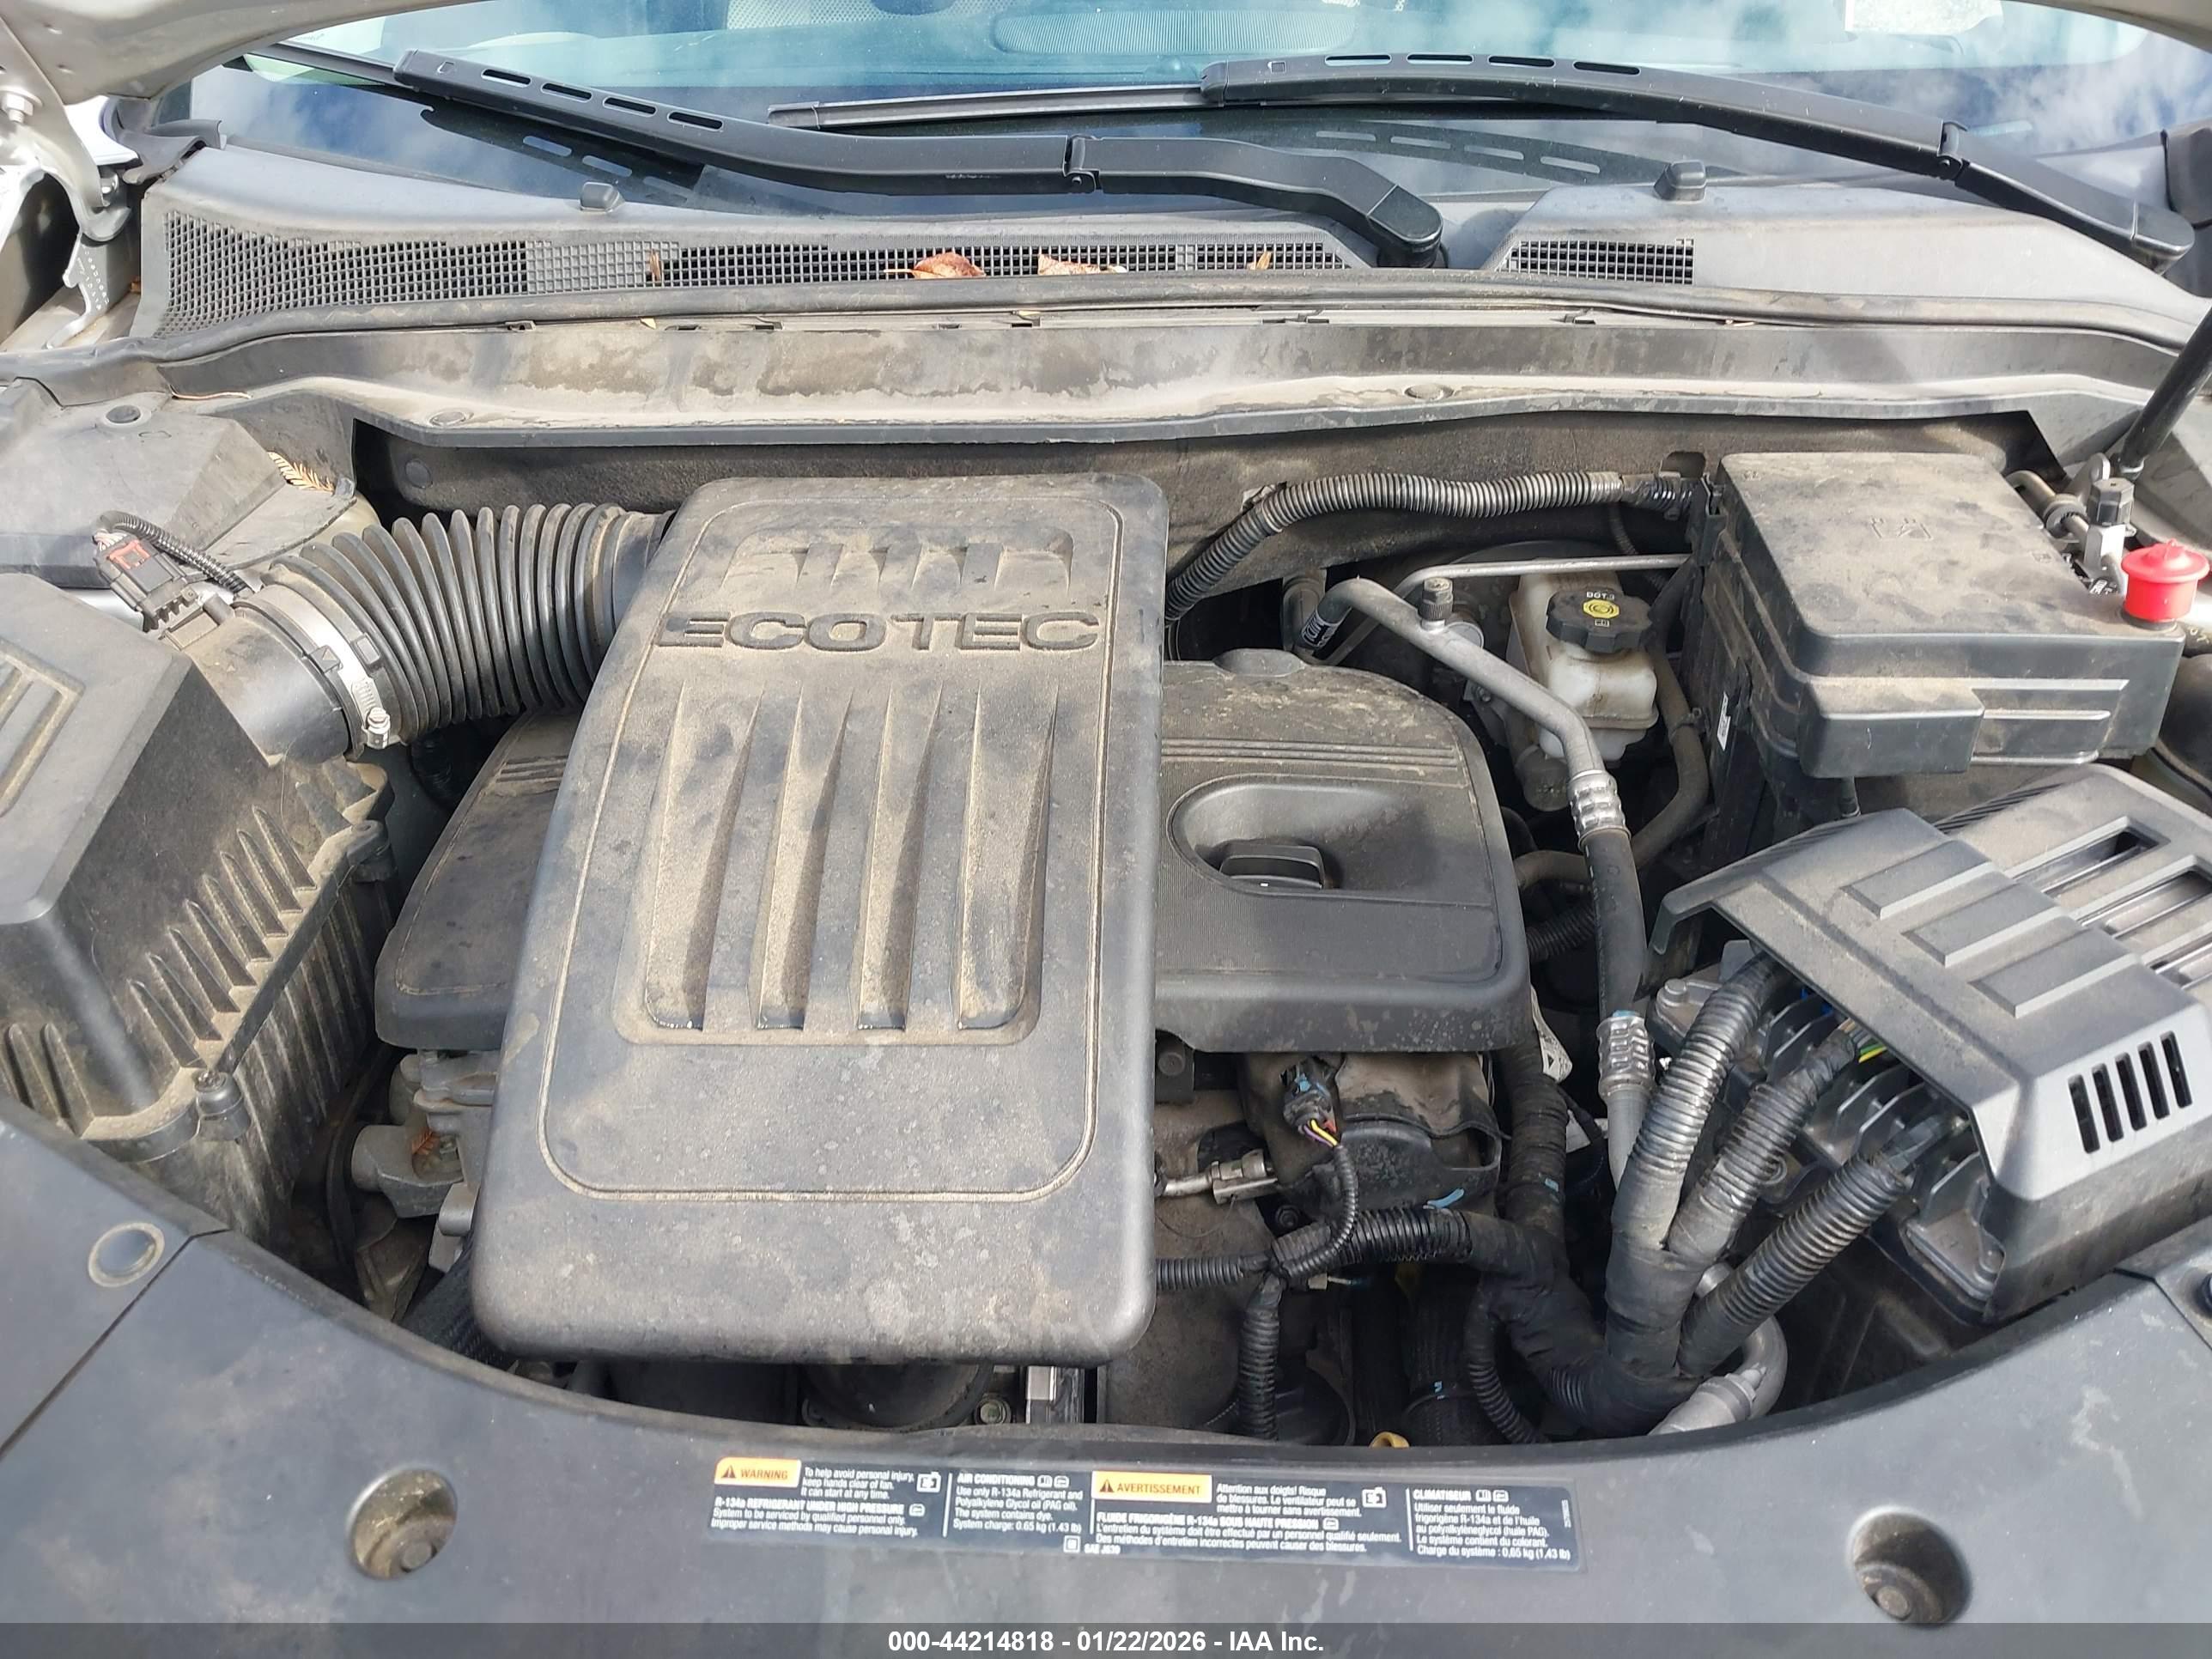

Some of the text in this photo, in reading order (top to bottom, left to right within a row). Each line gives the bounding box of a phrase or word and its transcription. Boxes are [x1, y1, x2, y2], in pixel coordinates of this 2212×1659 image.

[1586, 591, 1607, 599] DOT
[658, 611, 1100, 652] ECOTEC
[741, 1469, 788, 1480] WARNING
[805, 1468, 814, 1477] To
[815, 1468, 833, 1480] help
[833, 1469, 855, 1479] avoid
[855, 1470, 890, 1480] personal
[957, 1473, 1036, 1486] AIR CONDITIONING
[802, 1477, 895, 1490] keep hands clear of fan.
[1116, 1483, 1200, 1495] AVERTISSEMENT
[1216, 1483, 1253, 1494] Attention
[1253, 1486, 1269, 1495] aux
[1298, 1486, 1327, 1497] Risque
[808, 1488, 823, 1498] can
[824, 1488, 842, 1498] start
[843, 1489, 853, 1498] at
[854, 1490, 869, 1500] any
[870, 1490, 890, 1499] time.
[956, 1486, 1084, 1500] Use only R-134a Refrigerant and
[1413, 1489, 1472, 1502] CLIMATISEUR
[746, 1498, 805, 1510] REFRIGERANT
[806, 1500, 836, 1511] UNDER
[836, 1502, 859, 1512] HIGH
[860, 1503, 904, 1515] PRESSURE
[955, 1497, 1004, 1509] Polyalkylene
[1006, 1498, 1030, 1510] Glycol
[1030, 1499, 1042, 1510] oil
[1042, 1499, 1062, 1510] (PAG
[1216, 1494, 1228, 1504] de
[1270, 1494, 1281, 1504] Le
[1281, 1496, 1325, 1507] ventilateur
[1326, 1498, 1346, 1508] peut
[1346, 1498, 1357, 1507] se
[955, 1507, 1054, 1522] The system contains dye.
[1217, 1504, 1243, 1513] mettre
[1251, 1505, 1281, 1515] tourner
[1282, 1506, 1303, 1516] sans
[1414, 1502, 1521, 1516] Utiliser seulement le fluide
[713, 1507, 906, 1526] System to be serviced by qualified personnel only.
[1096, 1511, 1127, 1523] FLUIDE
[1218, 1516, 1243, 1528] SOUS
[1243, 1516, 1273, 1528] HAUTE
[1274, 1517, 1319, 1530] PRESSION
[1460, 1514, 1492, 1525] R-134a
[1492, 1515, 1501, 1525] et
[1502, 1516, 1514, 1526] de
[711, 1518, 748, 1530] Improper
[748, 1520, 777, 1530] service
[778, 1521, 814, 1532] methods
[814, 1523, 832, 1534] may
[833, 1524, 857, 1534] cause
[858, 1525, 893, 1535] personal
[953, 1518, 1082, 1534] System charge: 0.65 kg (1.43 lb)
[1139, 1524, 1152, 1534] du
[1187, 1526, 1203, 1537] doit
[1256, 1529, 1271, 1540] par
[1272, 1529, 1283, 1539] un
[1284, 1530, 1325, 1540] personnel
[1415, 1524, 1427, 1534] au
[1096, 1533, 1112, 1544] Des
[1199, 1537, 1245, 1549] incorrectes
[1245, 1539, 1279, 1550] peuvent
[1279, 1540, 1308, 1551] causer
[1308, 1541, 1325, 1552] des
[1416, 1534, 1428, 1545] Le
[1464, 1535, 1498, 1547] contient
[1499, 1536, 1511, 1547] du
[1417, 1545, 1448, 1558] Charge
[1448, 1546, 1460, 1557] du
[1522, 1547, 1535, 1561] kg
[1559, 1548, 1571, 1561] lb)
